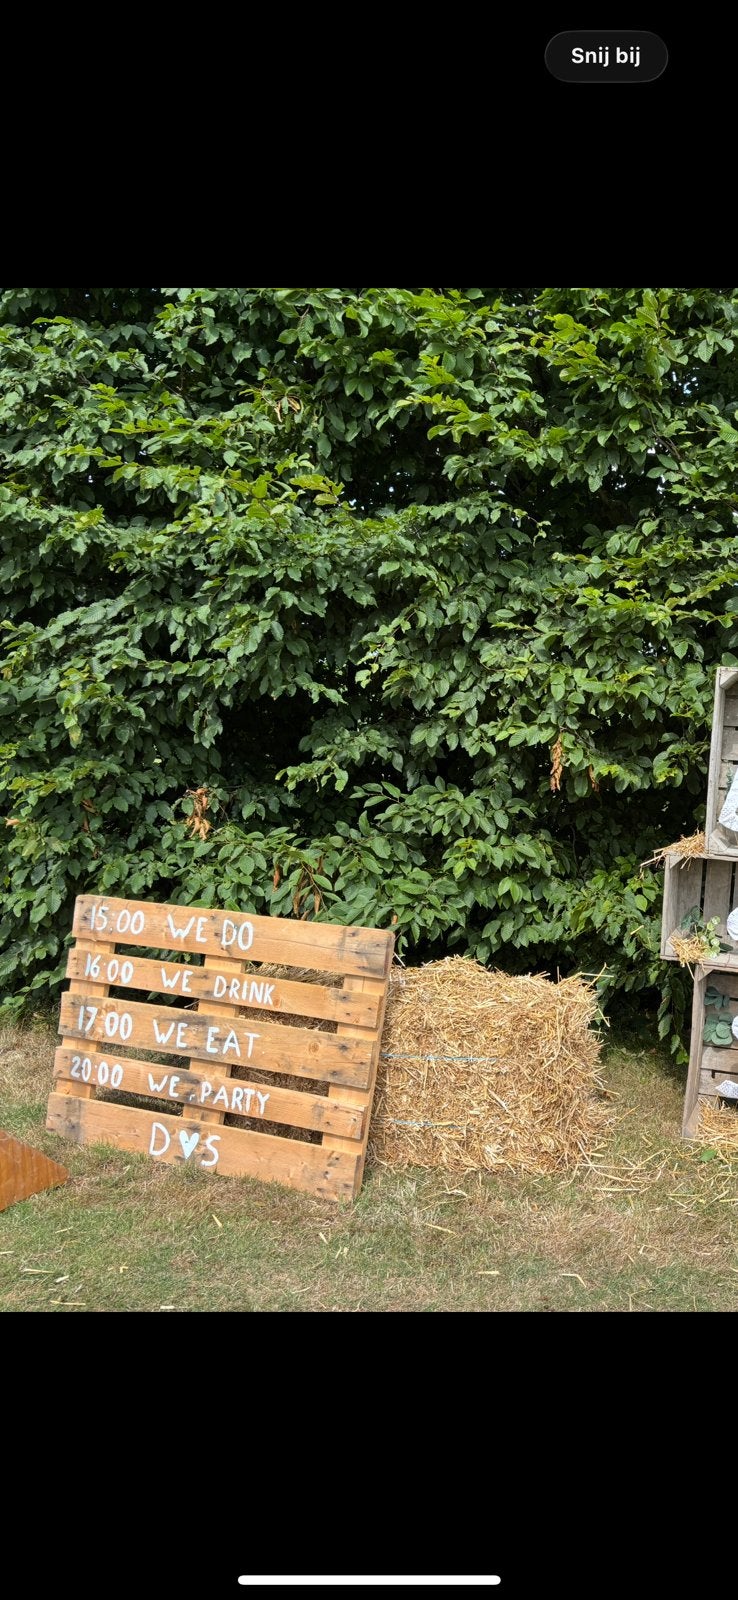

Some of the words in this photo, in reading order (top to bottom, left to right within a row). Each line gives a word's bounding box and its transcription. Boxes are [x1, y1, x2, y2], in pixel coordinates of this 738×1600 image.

[89, 905, 145, 935] 15:00
[167, 916, 208, 943] WE
[221, 919, 254, 950] DO
[161, 967, 194, 992] WE
[213, 975, 276, 1006] DRINK
[152, 1019, 188, 1048] WE
[206, 1027, 261, 1057] EAT
[70, 1056, 124, 1087] 20:00
[148, 1073, 180, 1098] WE
[200, 1081, 270, 1115] PARTY
[149, 1122, 170, 1156] D
[200, 1135, 221, 1166] S
